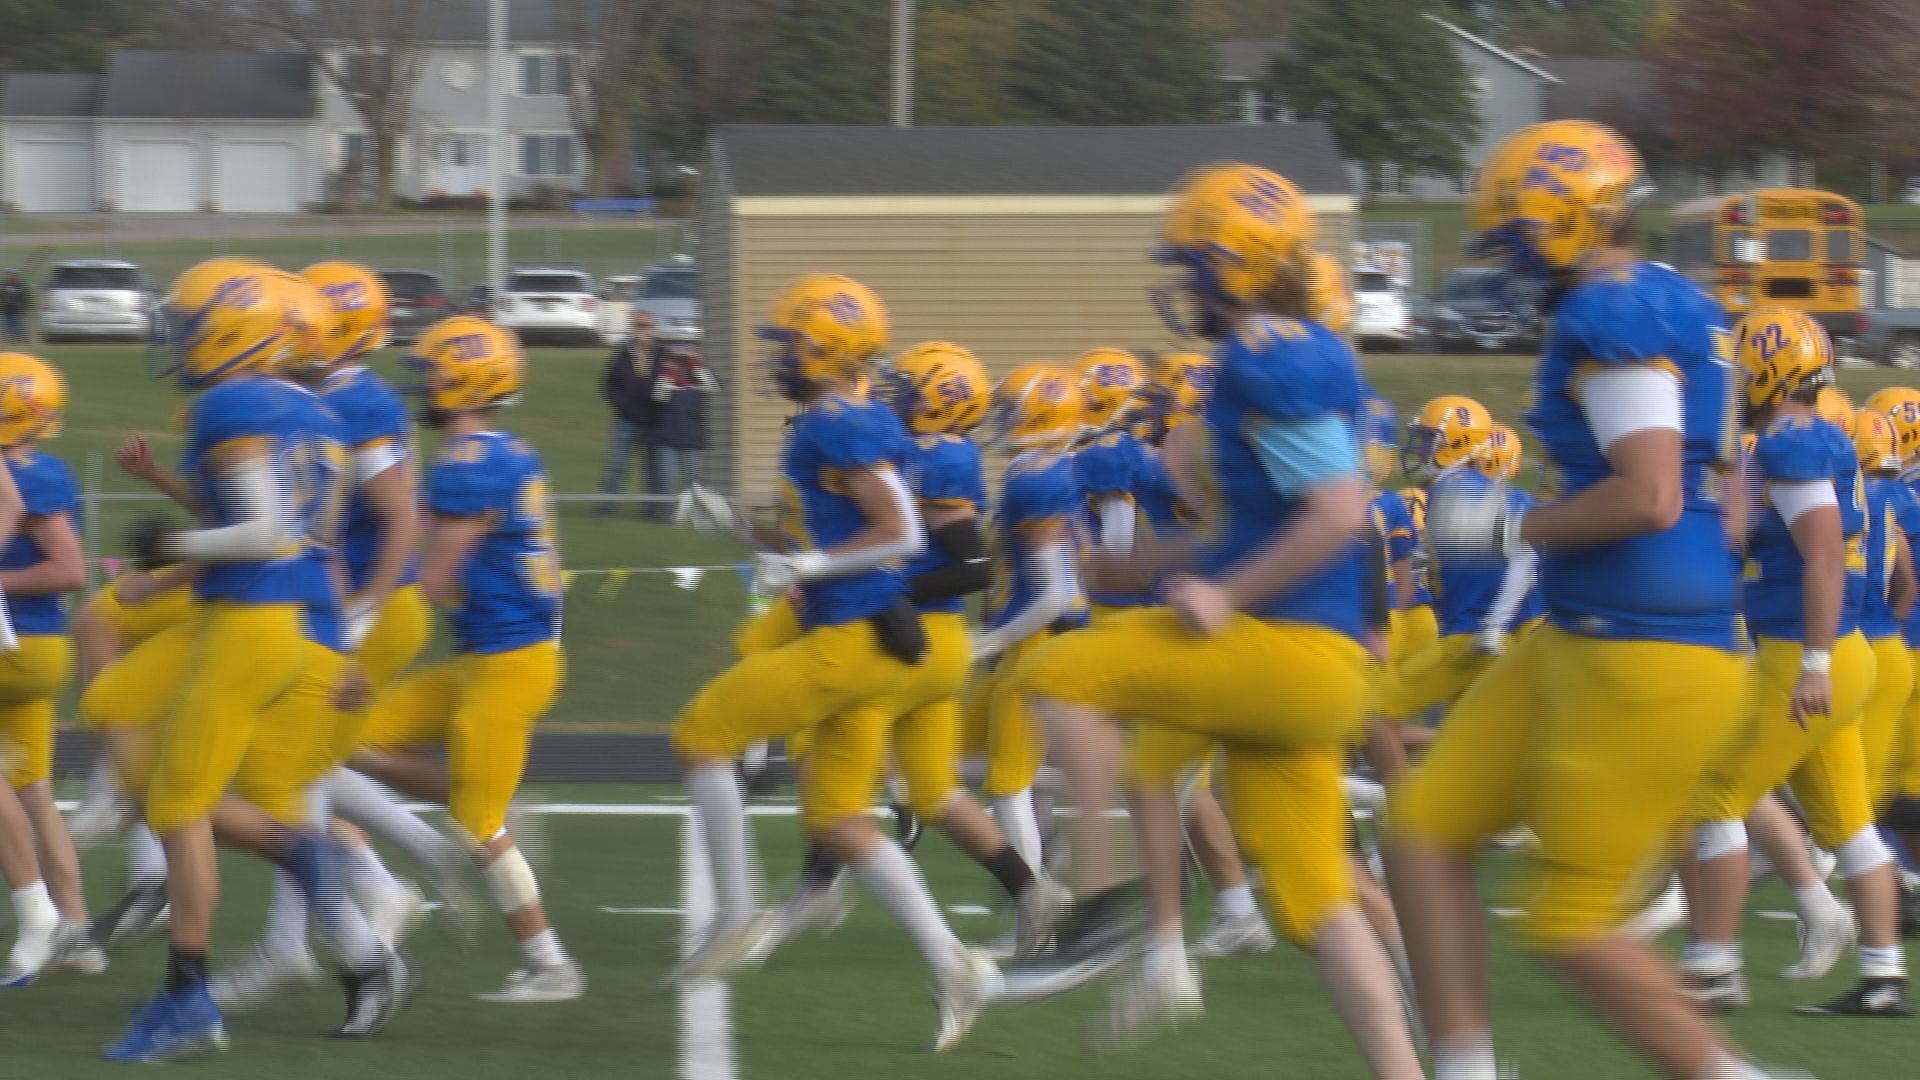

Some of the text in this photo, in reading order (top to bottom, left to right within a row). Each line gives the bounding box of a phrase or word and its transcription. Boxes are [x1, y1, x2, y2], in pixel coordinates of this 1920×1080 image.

[1751, 323, 1790, 361] 22
[1098, 364, 1133, 388] 88
[937, 375, 974, 408] 58
[1455, 408, 1471, 427] 9
[1903, 401, 1920, 424] 5
